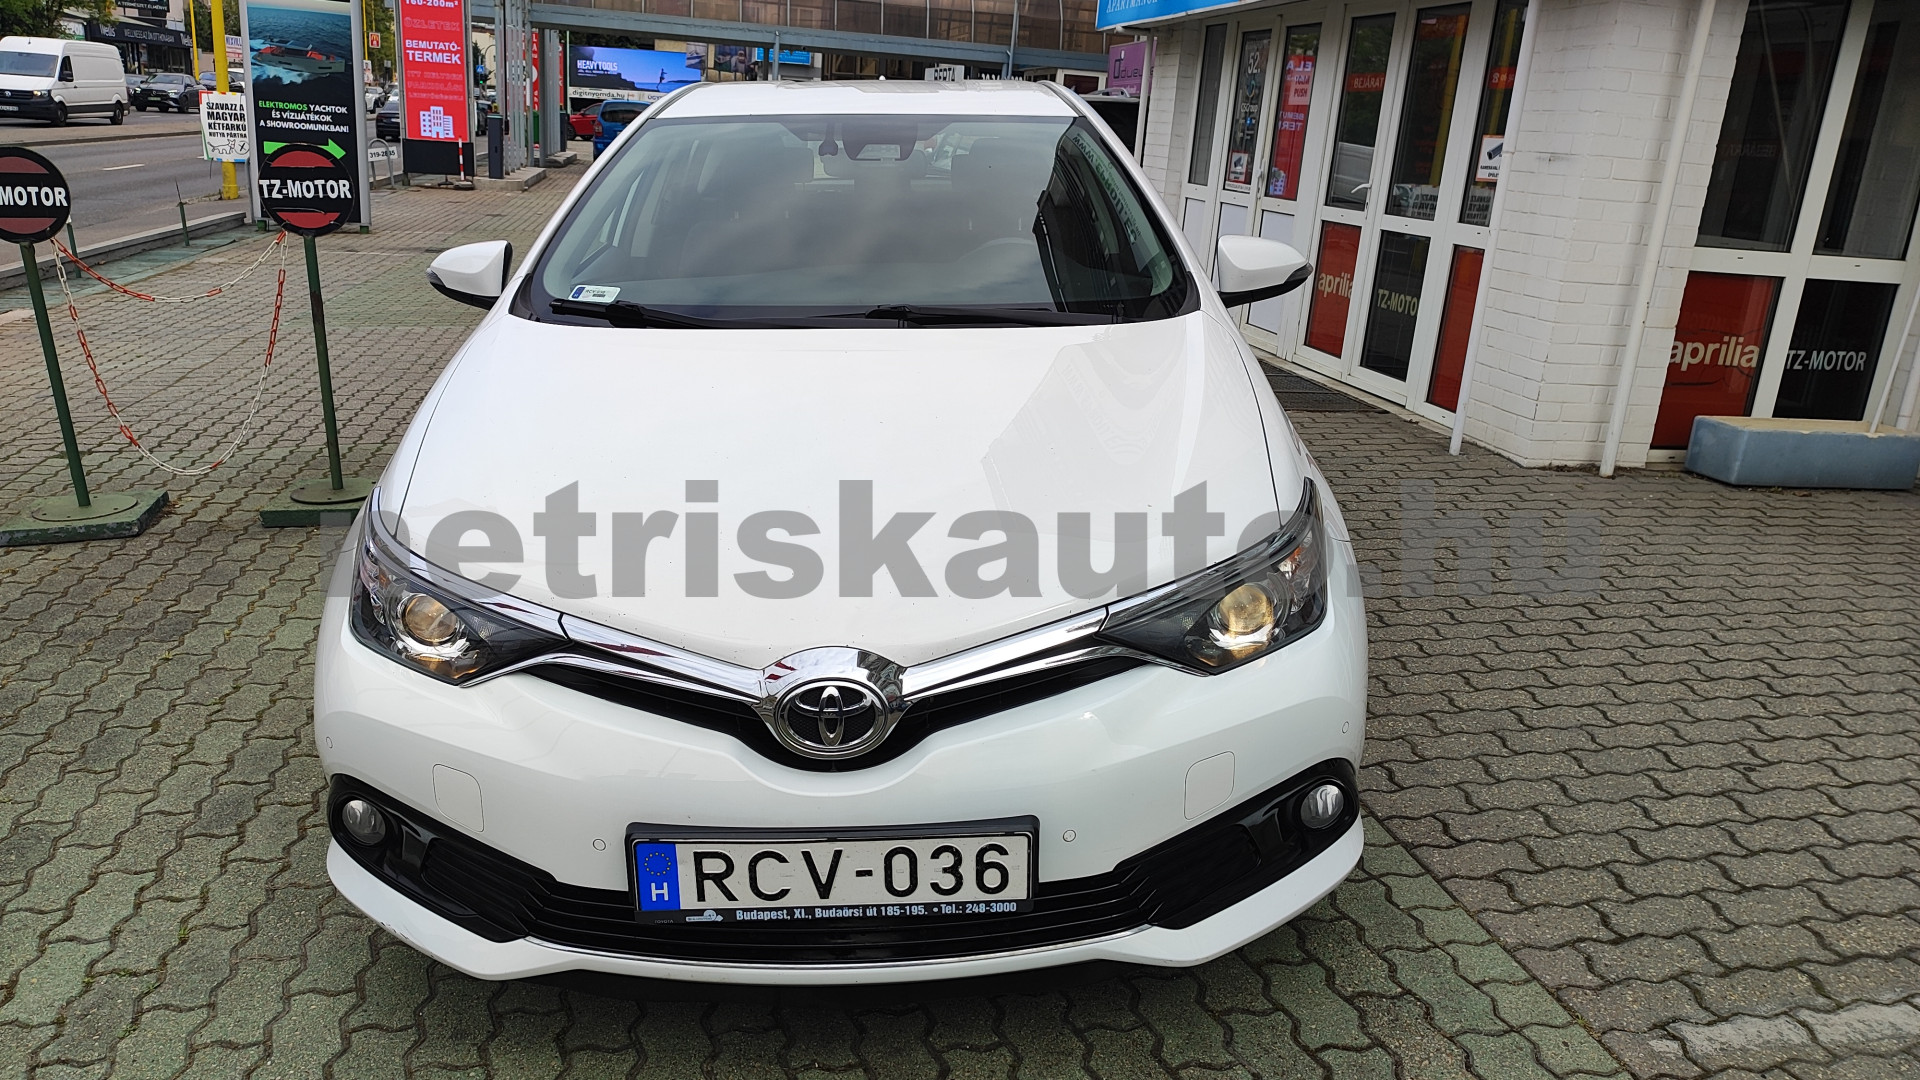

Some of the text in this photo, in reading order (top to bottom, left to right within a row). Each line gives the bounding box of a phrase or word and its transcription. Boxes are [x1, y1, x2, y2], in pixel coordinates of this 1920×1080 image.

[1106, 0, 1158, 13] APARTMAN
[405, 39, 461, 50] BEMUTATÓ-
[406, 50, 462, 64] TERMEK
[206, 101, 245, 111] SZAVAZZ A
[259, 100, 348, 114] ELEKTROMOS YACHTOK
[207, 111, 246, 122] MAGYAR
[271, 110, 281, 118] ÉS
[208, 121, 246, 131] KÉTFARKÚ
[266, 121, 350, 133] SHOWROOMUNKBAN!
[259, 179, 352, 199] TZ-MOTOR
[1669, 336, 1760, 372] aprilia
[1786, 350, 1867, 371] TZ-MOTOR
[650, 843, 1010, 903] H RCV-036
[736, 910, 791, 920] Budapest,
[815, 906, 863, 918] Budaörsi
[866, 906, 877, 916] út
[880, 905, 928, 916] 185-195.
[940, 904, 963, 914] Tel.:
[965, 902, 1017, 914] 248-3000
